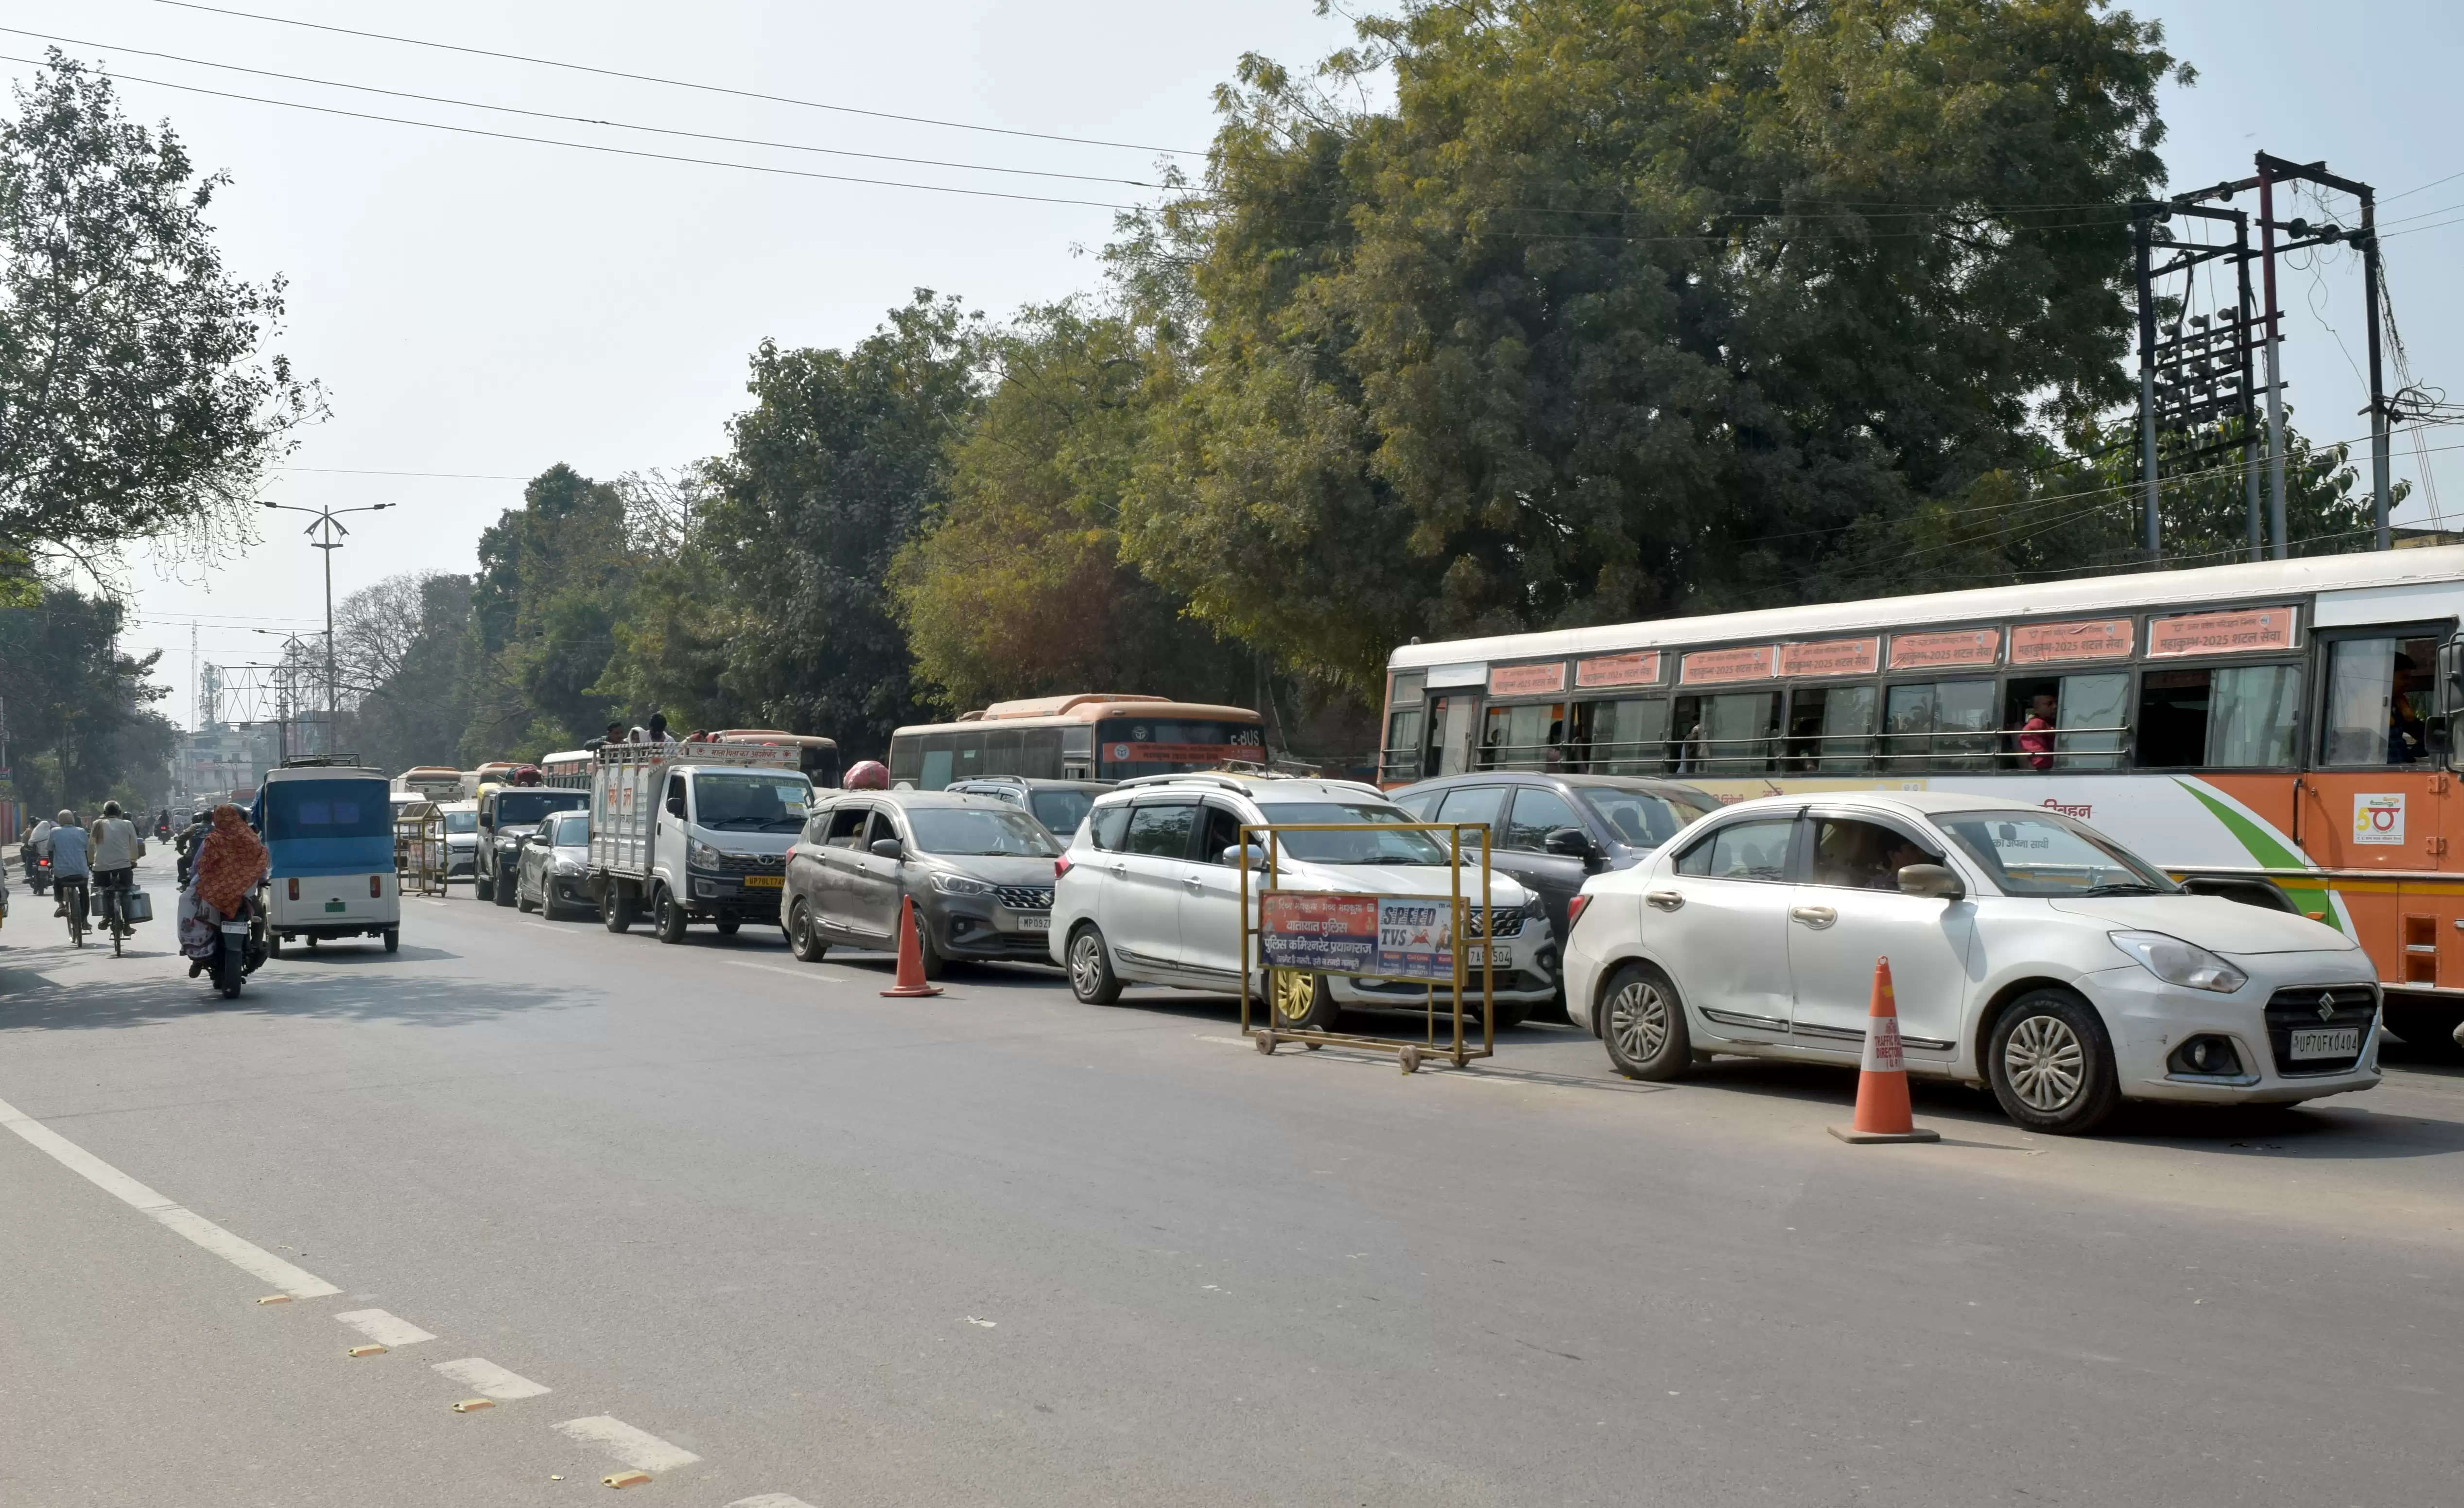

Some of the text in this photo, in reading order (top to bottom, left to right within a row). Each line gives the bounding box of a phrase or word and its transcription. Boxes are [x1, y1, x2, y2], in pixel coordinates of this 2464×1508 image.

[2081, 639, 2103, 650] शटल
[2106, 636, 2124, 649] सेवा
[2232, 631, 2257, 644] शटल
[2260, 628, 2281, 641] सेवा
[1231, 730, 1260, 746] E-BUS
[2030, 837, 2049, 848] साथी
[1383, 906, 1437, 926] SPEED
[1286, 917, 1348, 937] यातायात पुलिस
[1264, 935, 1372, 954] पुलिस कमिश्नरेट प्रयागराज
[1381, 928, 1407, 946] TVS
[1874, 1035, 1893, 1047] TRAFFIC
[2300, 1034, 2357, 1052] UP70FK0404
